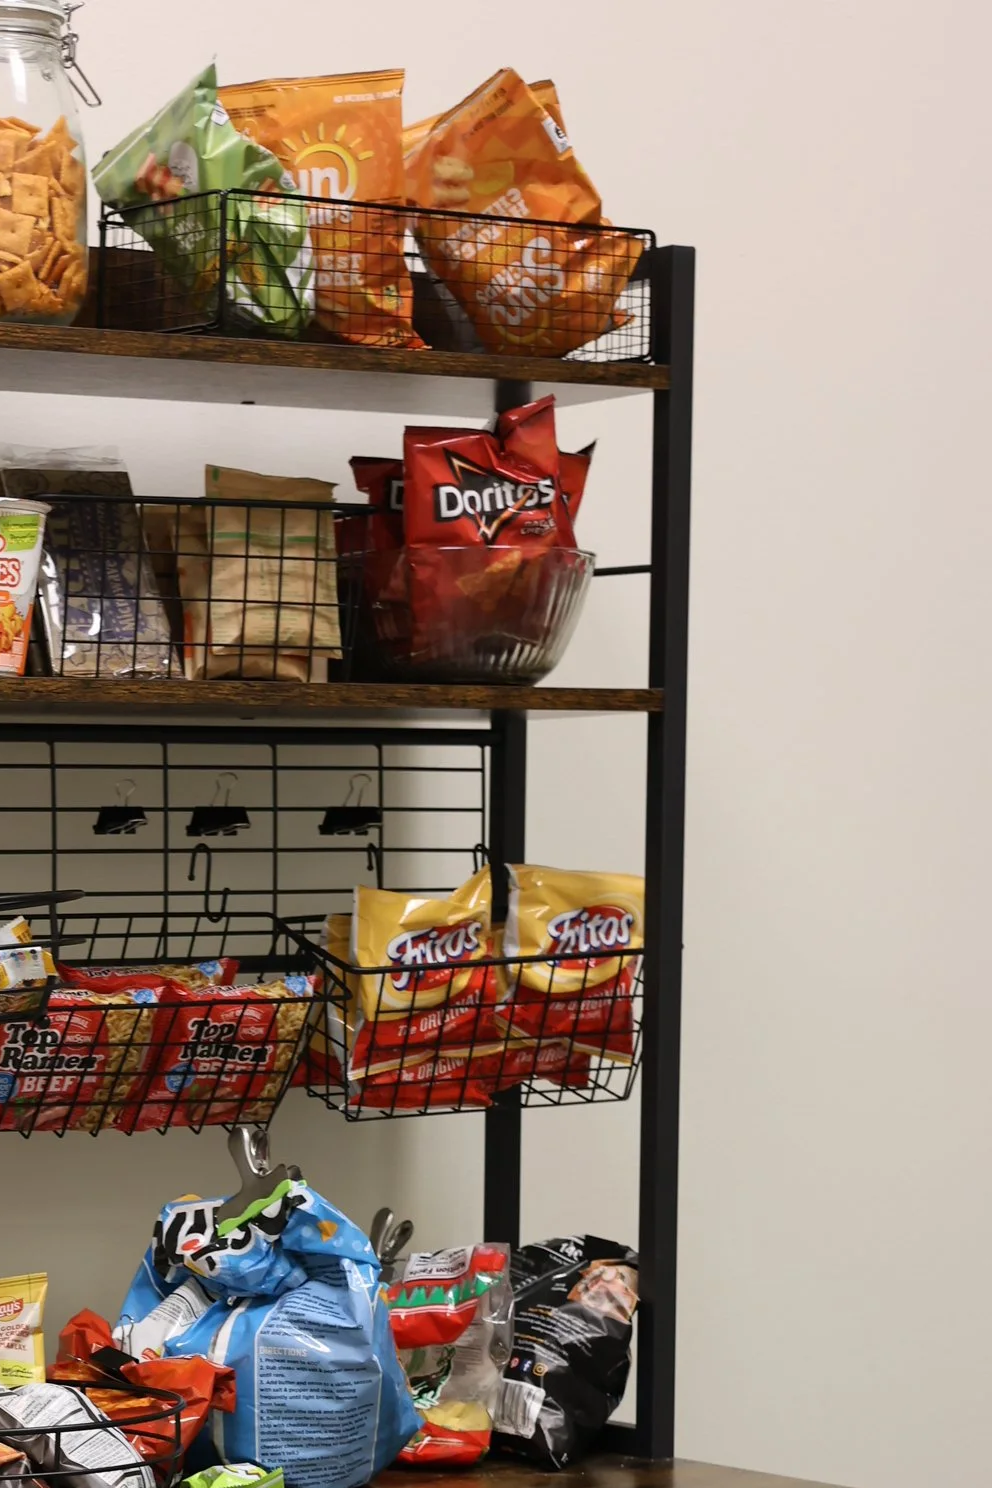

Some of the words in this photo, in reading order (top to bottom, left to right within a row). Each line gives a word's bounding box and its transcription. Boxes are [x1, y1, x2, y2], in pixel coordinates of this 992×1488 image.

[438, 479, 556, 519] Doritos
[547, 909, 635, 967] Fritos
[387, 920, 483, 991] Fritos
[419, 989, 481, 1032] ORIGINAL
[4, 1022, 61, 1054] Top
[188, 1017, 236, 1043] Top
[178, 1041, 270, 1065] Ramen
[21, 1075, 76, 1092] BEEF
[259, 1346, 308, 1357] DIRECTIONS
